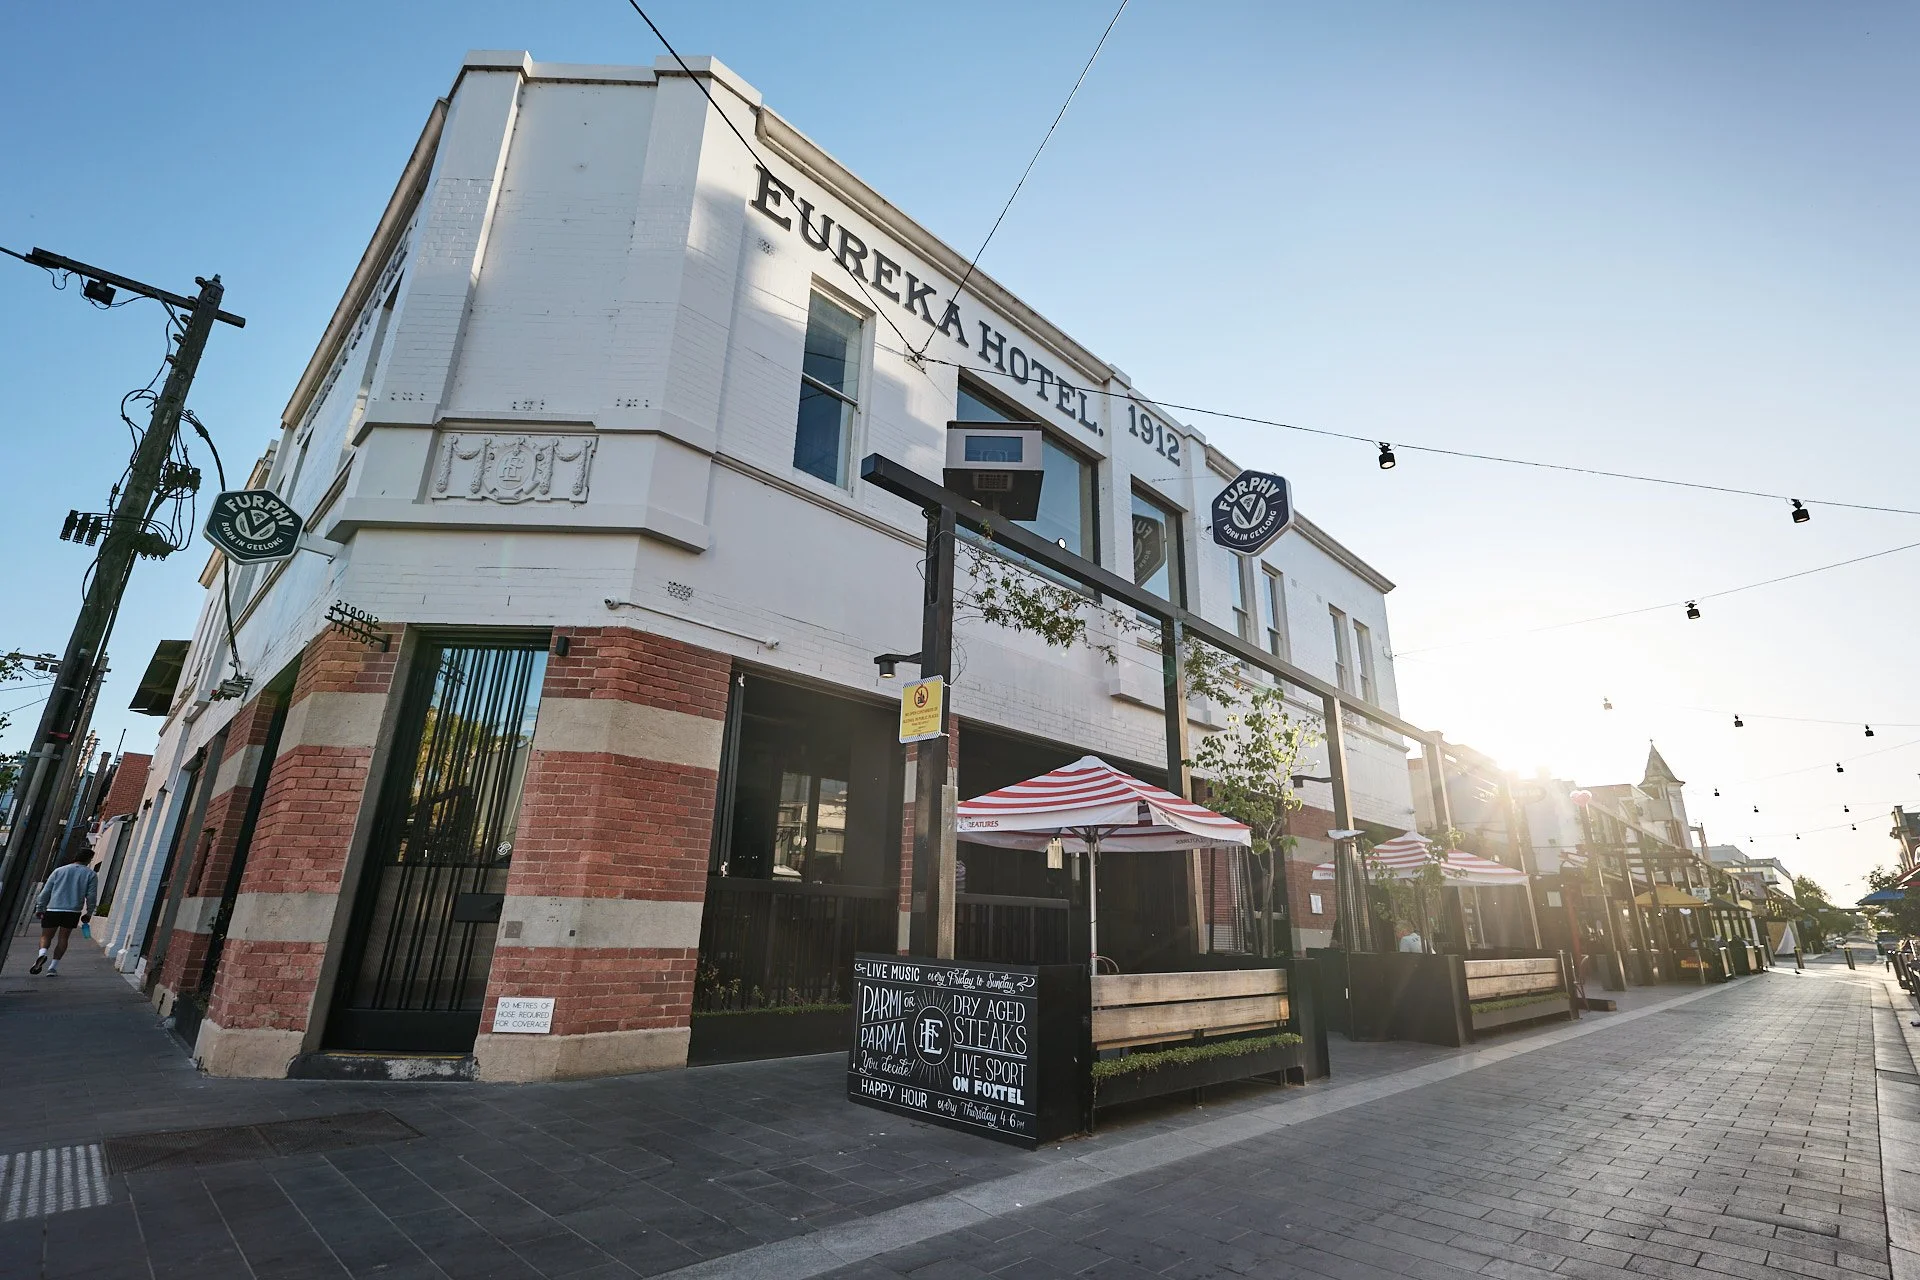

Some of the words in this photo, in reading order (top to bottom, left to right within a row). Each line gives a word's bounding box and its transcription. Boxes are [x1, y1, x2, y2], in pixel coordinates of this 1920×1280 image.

[749, 163, 969, 349] EUREKA
[1127, 403, 1181, 467] 1912
[224, 494, 294, 527] FURPHY
[1218, 477, 1280, 511] FURPHY
[221, 522, 237, 541] BORN
[235, 539, 245, 547] IN
[246, 537, 283, 551] GEELONG
[1223, 523, 1239, 540] BORN
[1249, 510, 1277, 539] GEELONG
[866, 963, 888, 979] LIVE
[891, 965, 920, 982] MUSIC
[947, 969, 975, 990] Friday
[977, 975, 984, 986] to
[986, 973, 1016, 994] Sunday
[518, 1011, 550, 1019] REQUIRED
[862, 985, 902, 1023] PARMI
[904, 996, 916, 1008] OR
[953, 994, 981, 1017] DRY
[986, 1000, 1026, 1023] AGED
[511, 1020, 549, 1028] COVERAGE
[860, 1021, 908, 1056] PARMA
[952, 1016, 1027, 1055] STEAKS
[859, 1050, 879, 1076] You
[881, 1055, 916, 1078] decide!
[953, 1051, 982, 1078] LIVE
[985, 1058, 1027, 1087] SPORT
[861, 1078, 895, 1099] HAPPY
[901, 1088, 928, 1109] HOUR
[937, 1099, 957, 1116] every
[960, 1101, 998, 1129] Thursday
[952, 1076, 969, 1093] ON
[974, 1079, 1025, 1106] FOXTEL
